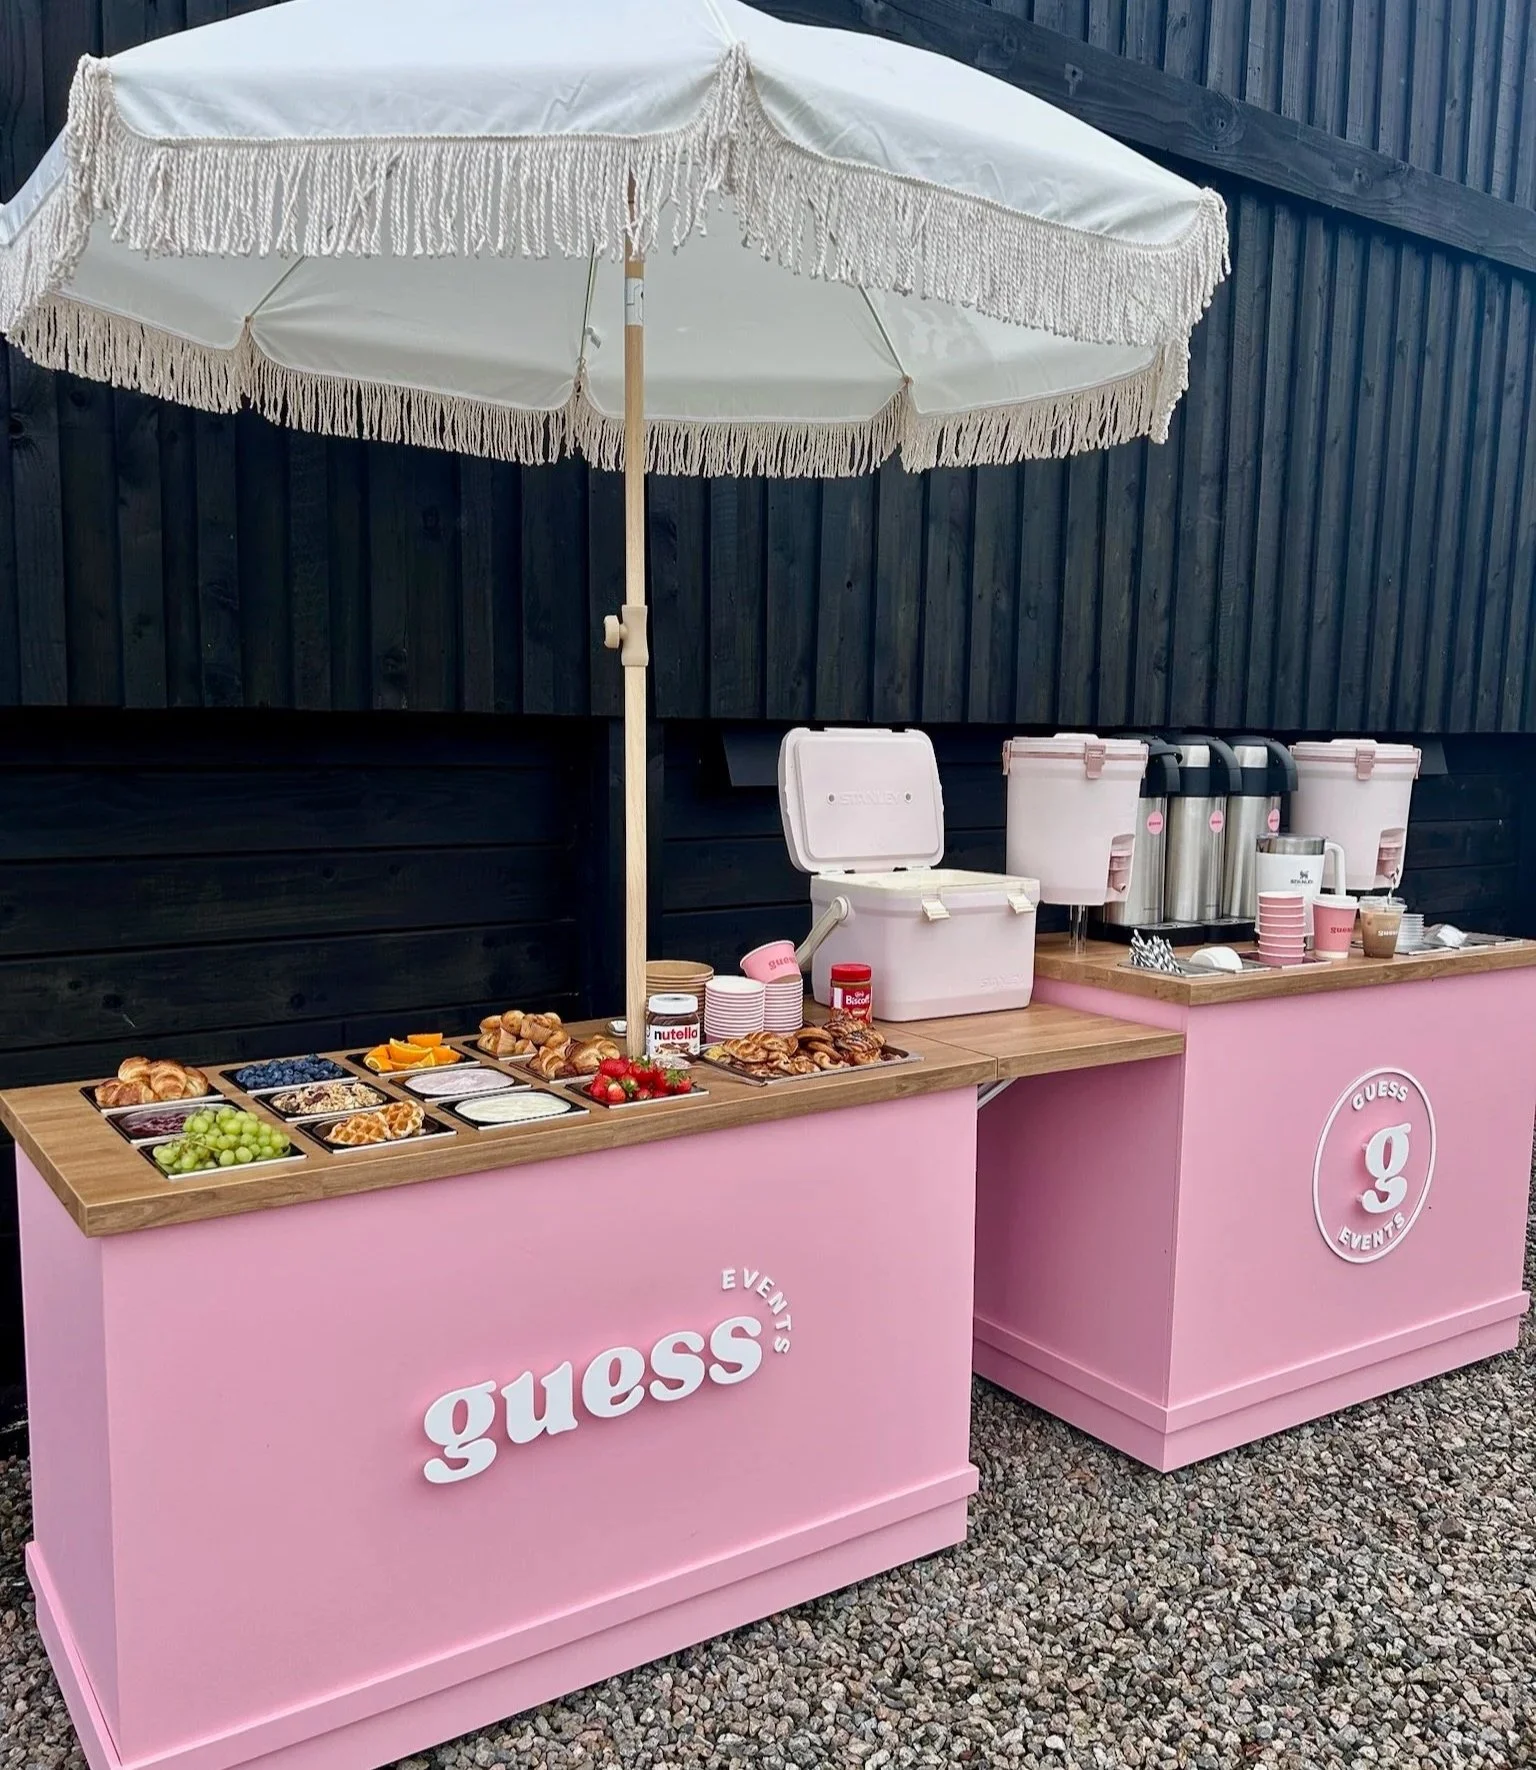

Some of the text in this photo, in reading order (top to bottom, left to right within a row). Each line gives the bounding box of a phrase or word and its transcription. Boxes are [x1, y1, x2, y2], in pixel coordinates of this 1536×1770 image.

[654, 1025, 698, 1041] nutella
[1352, 1079, 1409, 1112] GUESS
[1363, 1122, 1412, 1215] g
[1339, 1211, 1406, 1251] EVENTS
[721, 1267, 793, 1355] EVENTS
[423, 1315, 764, 1485] guess
